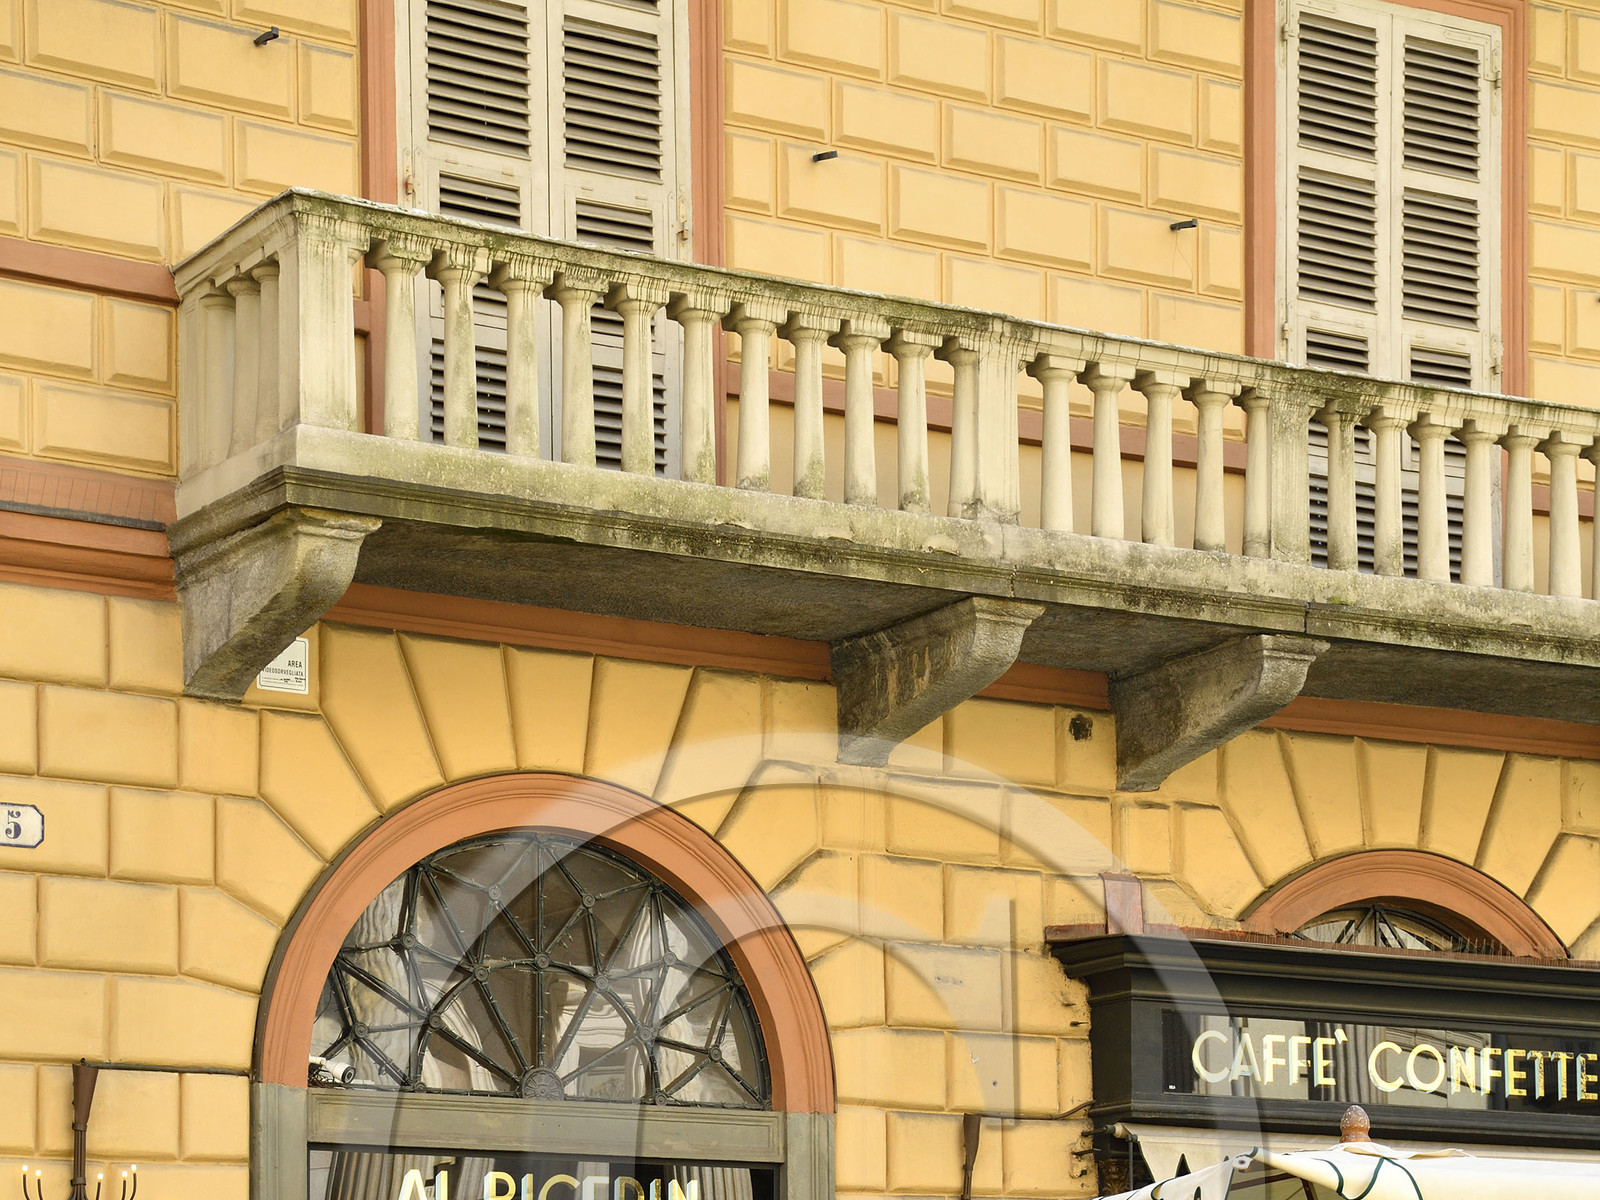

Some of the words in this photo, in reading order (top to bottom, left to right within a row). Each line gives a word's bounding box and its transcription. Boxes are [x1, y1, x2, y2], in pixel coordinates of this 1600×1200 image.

[262, 667, 304, 677] IDEOSORVEGLIATA
[287, 660, 303, 668] AREA
[5, 810, 22, 839] 5
[1368, 1041, 1599, 1102] CONFETTE
